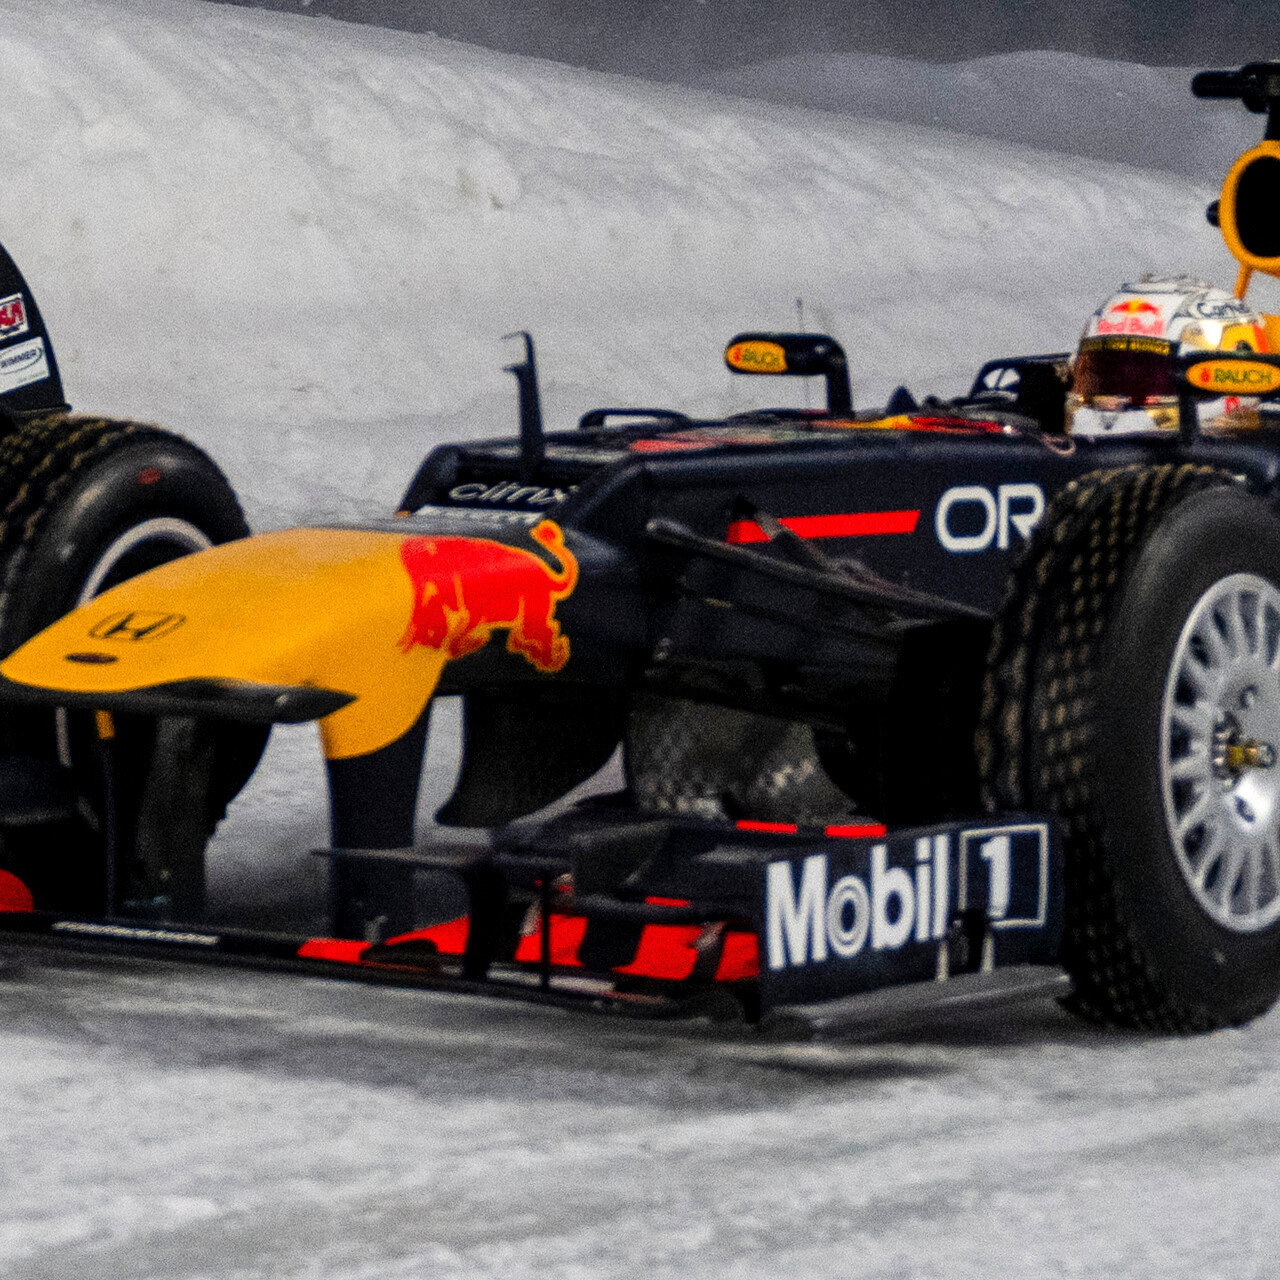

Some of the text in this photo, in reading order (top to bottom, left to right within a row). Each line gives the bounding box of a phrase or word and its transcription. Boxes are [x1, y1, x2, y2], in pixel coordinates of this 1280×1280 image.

[1213, 366, 1271, 384] RAUCH
[766, 833, 1011, 971] Mobil 1
